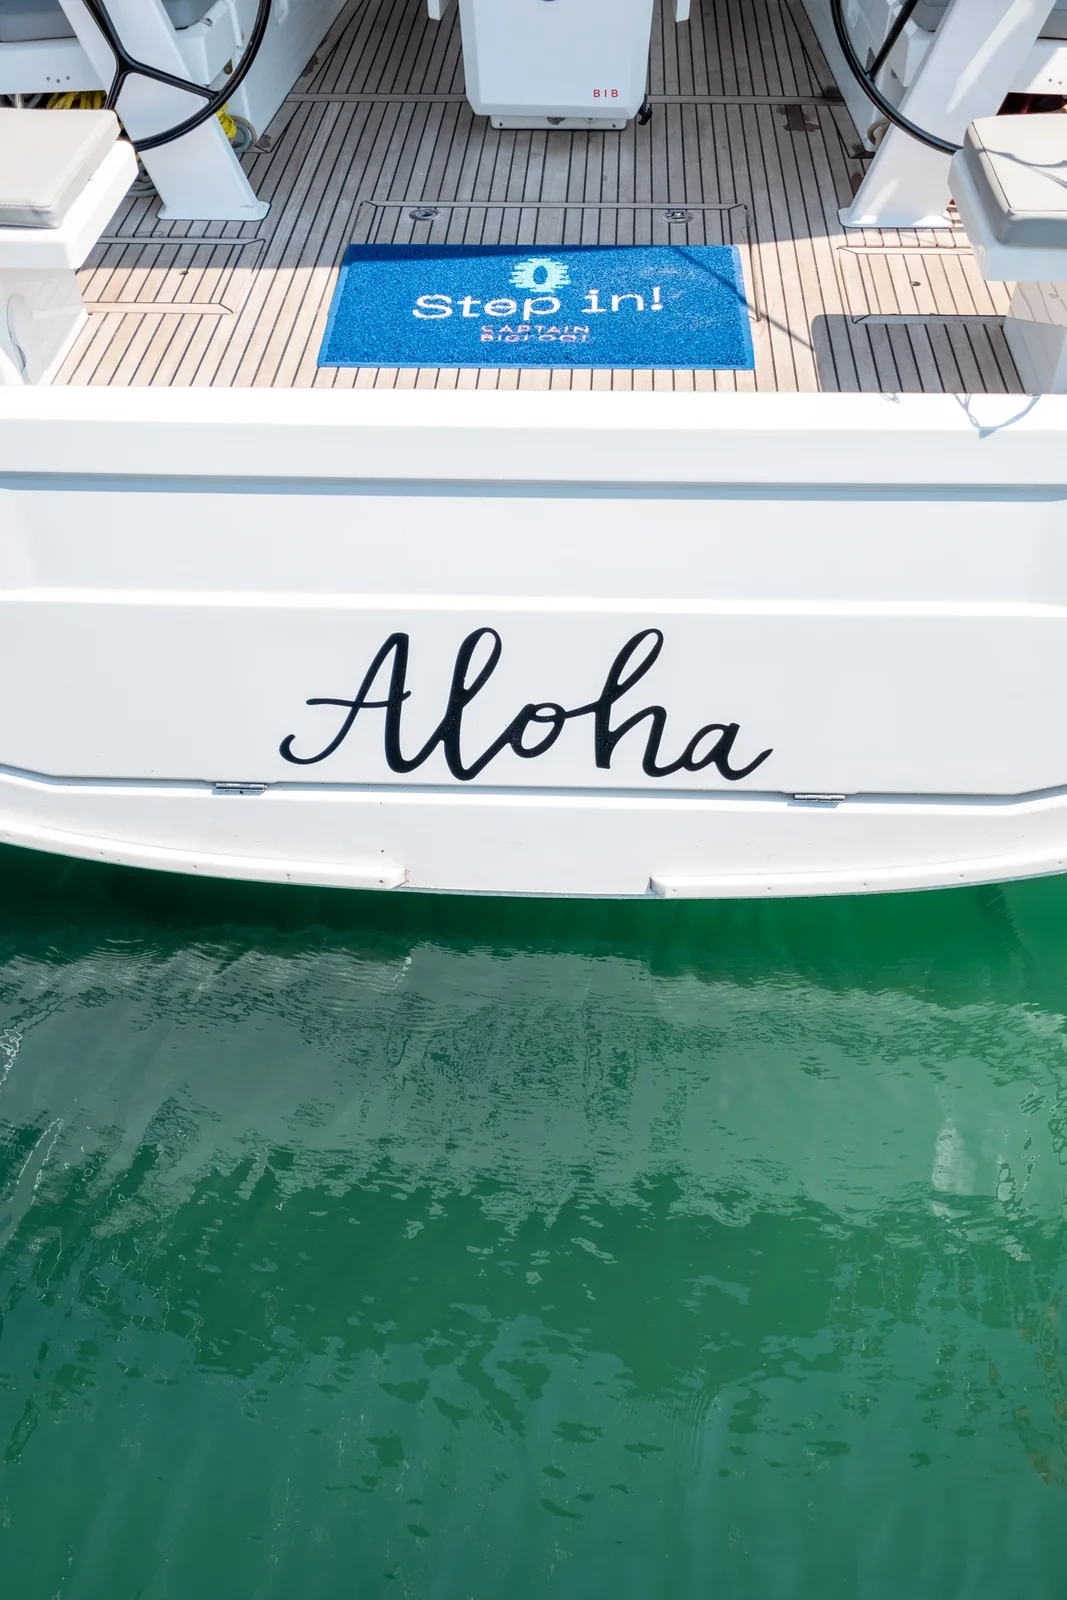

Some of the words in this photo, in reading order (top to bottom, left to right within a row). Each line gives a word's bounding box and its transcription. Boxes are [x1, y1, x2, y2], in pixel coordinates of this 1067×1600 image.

[593, 89, 619, 98] BIB
[412, 294, 560, 321] Step
[581, 286, 663, 313] in!
[481, 324, 589, 333] CAPTAIN
[279, 627, 773, 781] Aloha
